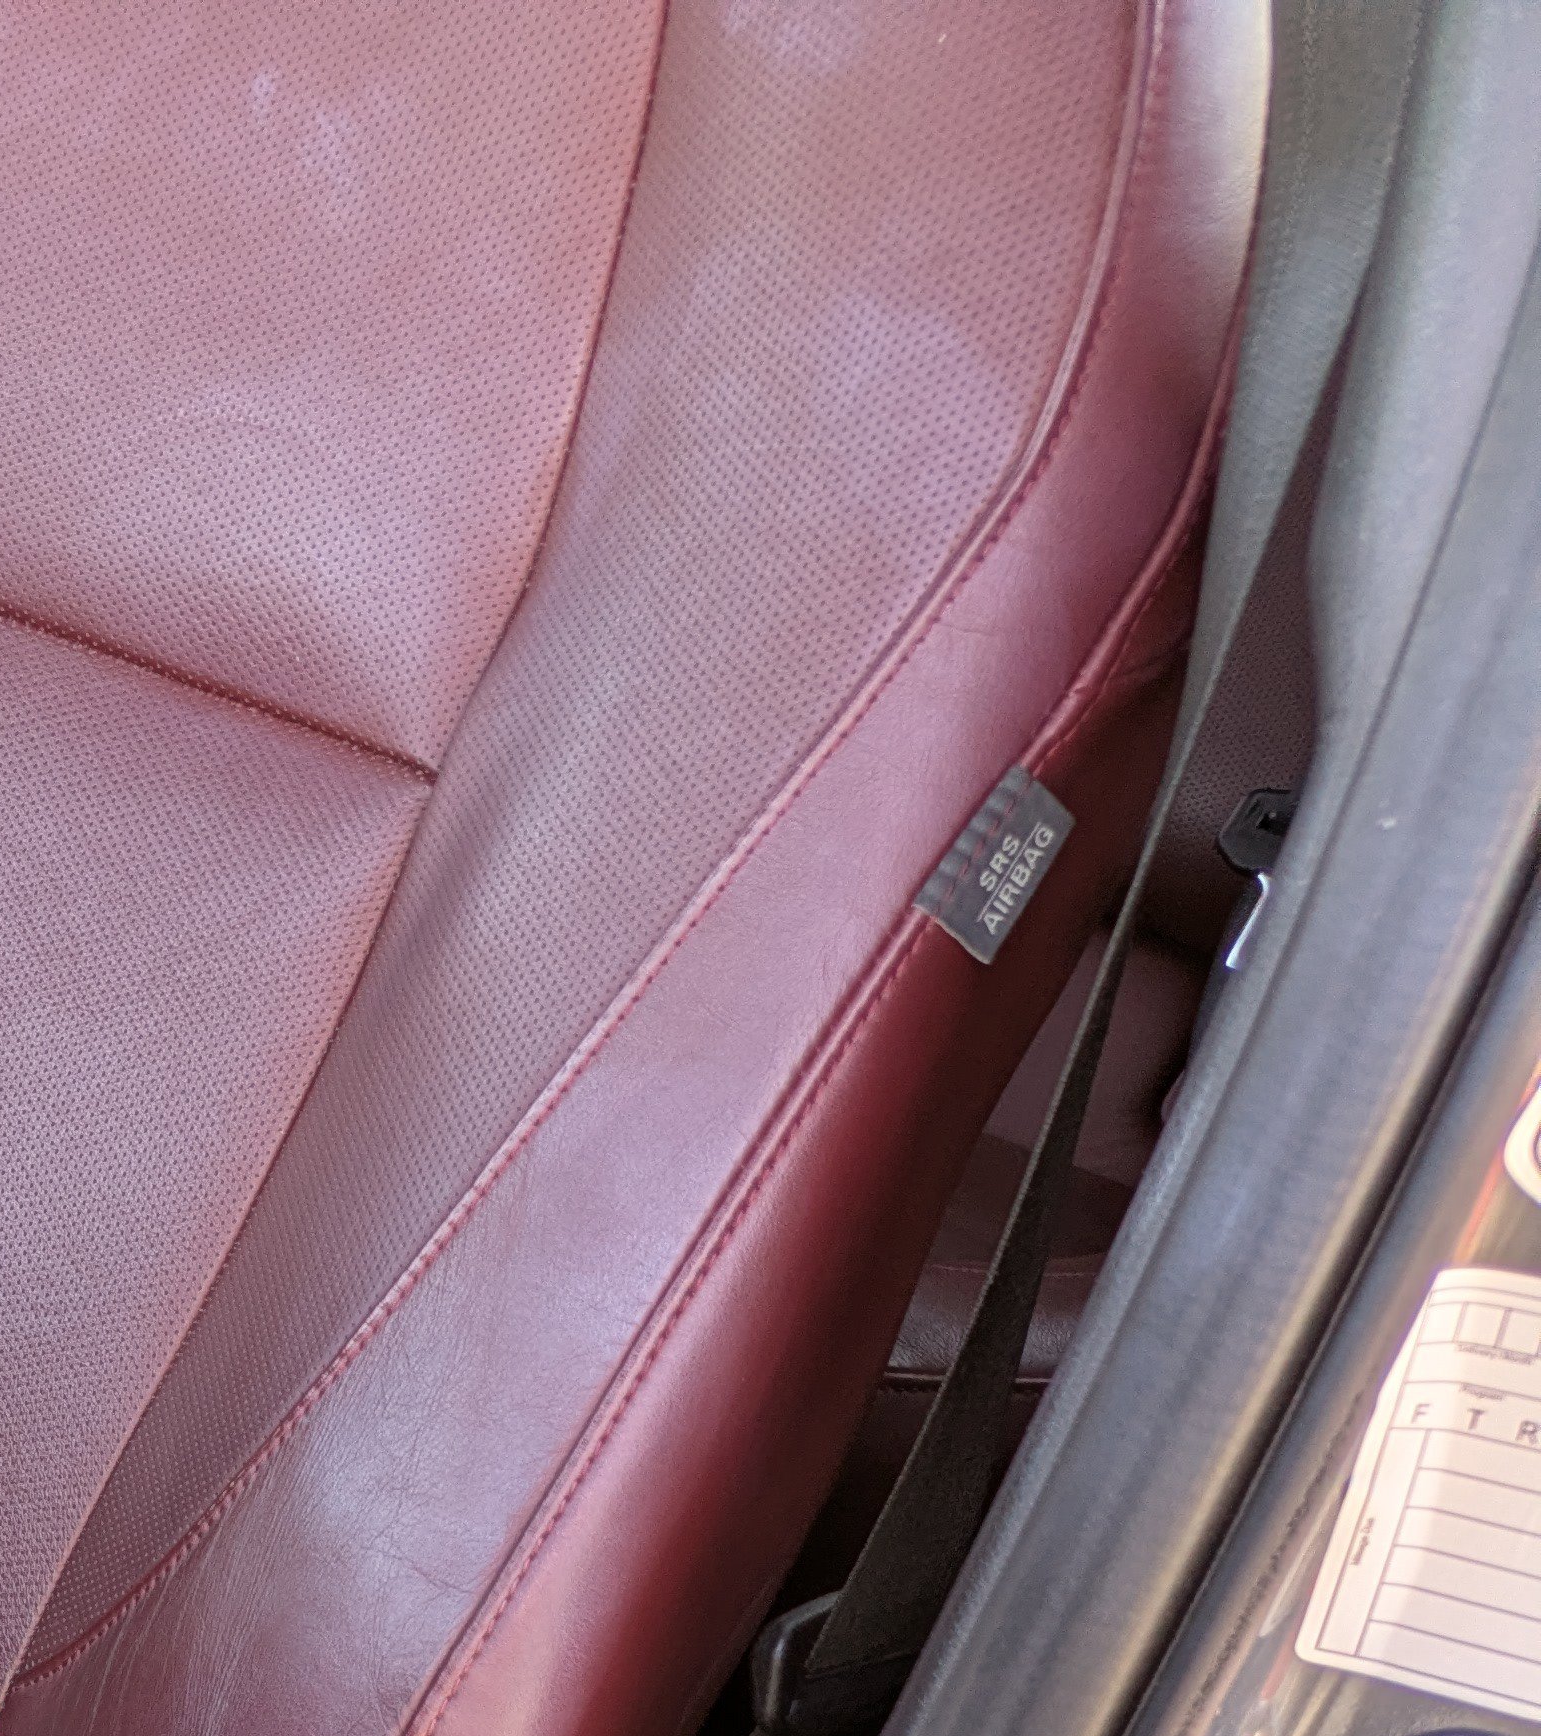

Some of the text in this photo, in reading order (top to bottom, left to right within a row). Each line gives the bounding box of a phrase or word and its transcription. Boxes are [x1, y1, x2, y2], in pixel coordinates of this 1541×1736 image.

[980, 835, 1019, 891] SRS
[984, 826, 1054, 935] AIRBAG
[1411, 1403, 1430, 1424] F
[1468, 1408, 1485, 1430] T
